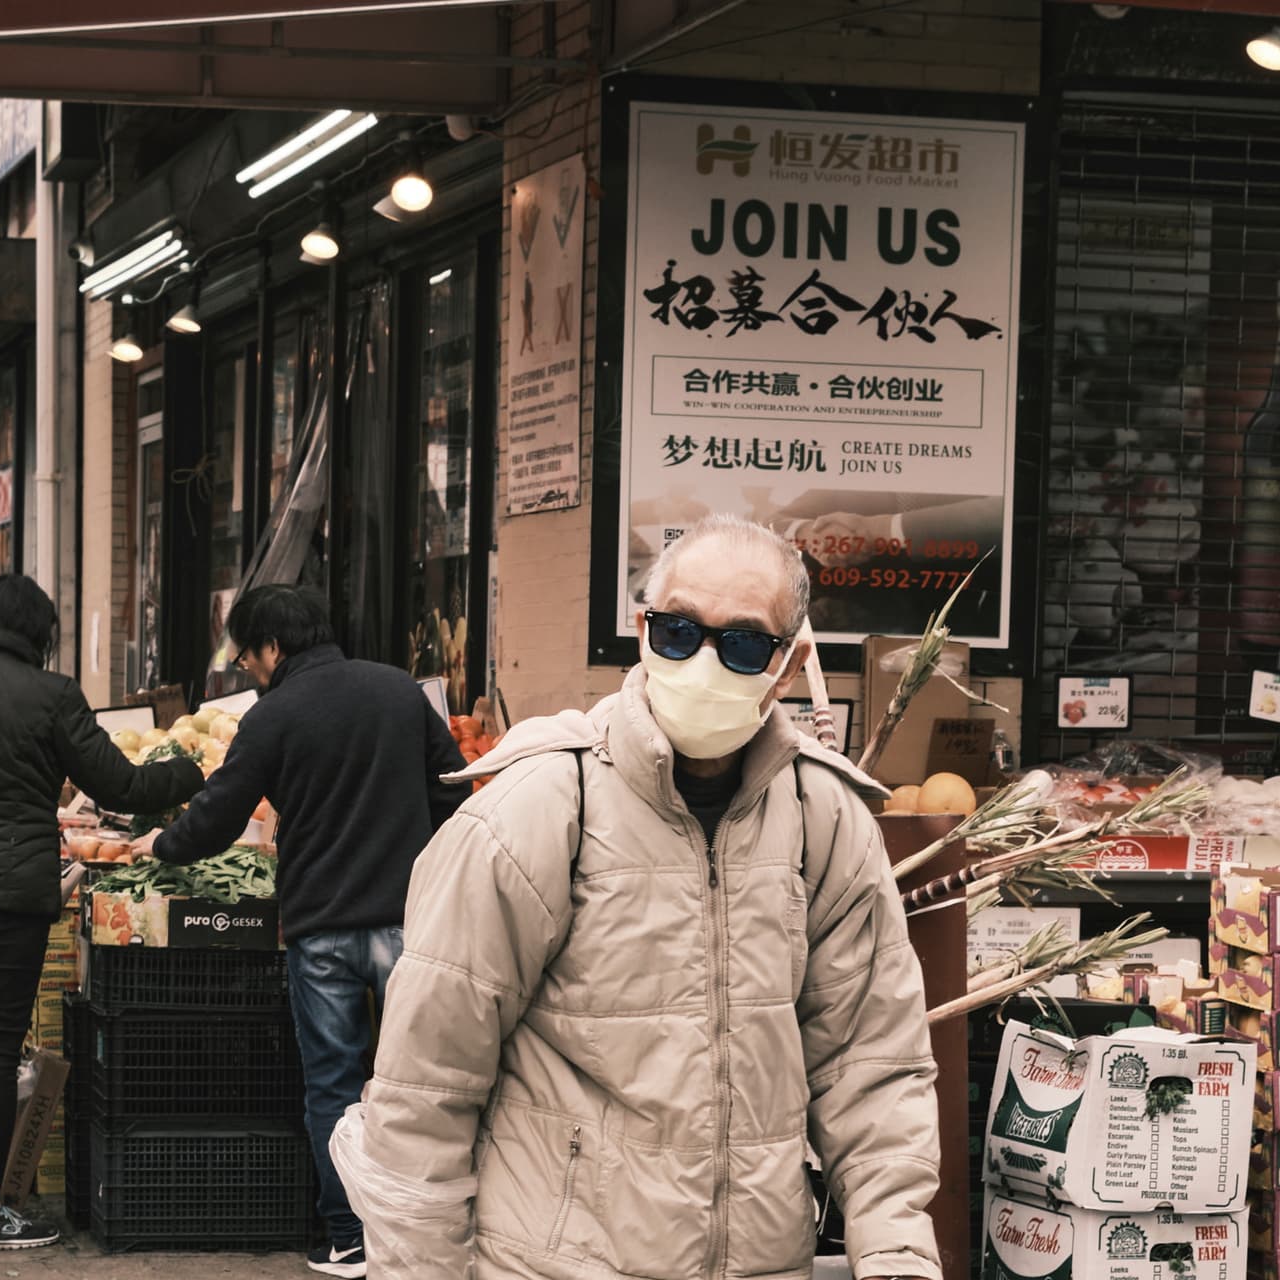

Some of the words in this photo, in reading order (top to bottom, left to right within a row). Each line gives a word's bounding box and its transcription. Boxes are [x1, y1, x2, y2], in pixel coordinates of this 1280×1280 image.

[770, 128, 961, 175] 恒发超市
[866, 173, 903, 187] Food
[908, 175, 960, 189] Market
[691, 198, 849, 262] JOIN
[877, 207, 961, 267] US
[644, 260, 1003, 344] 招募合伙人
[733, 402, 809, 413] COOPERATION
[812, 405, 835, 415] AND
[838, 406, 943, 419] ENTREPRENEURSHIP
[662, 433, 827, 473] 梦想起航
[841, 440, 904, 457] CREATE
[908, 443, 973, 459] DREAMS
[839, 459, 877, 475] JOIN
[882, 460, 903, 474] US
[1194, 838, 1209, 861] FUJI
[231, 918, 264, 927] GESEX
[1162, 1049, 1178, 1058] 1.35
[1022, 1047, 1054, 1086] Farm
[1197, 1061, 1234, 1076] FRESH
[1197, 1081, 1230, 1097] FARM
[1109, 1104, 1138, 1113] Dandelion
[1006, 1101, 1064, 1144] VEGETABLES
[1173, 1116, 1187, 1125] Kale
[1108, 1123, 1120, 1131] Red
[1172, 1125, 1199, 1134] Mustard
[1107, 1132, 1134, 1141] Escarole
[1172, 1136, 1187, 1144] Tops
[1107, 1142, 1128, 1150] Endive
[1193, 1146, 1218, 1155] Spinach
[1106, 1151, 1123, 1161] Curly
[1124, 1152, 1147, 1161] Parsley
[1172, 1154, 1197, 1163] Spinach
[1106, 1161, 1123, 1169] Plain
[1124, 1162, 1146, 1171] Parsley
[1105, 1170, 1117, 1178] Red
[1118, 1170, 1133, 1179] Leaf
[1170, 1173, 1194, 1182] Turnips
[1105, 1179, 1123, 1188] Green
[1124, 1180, 1139, 1189] Leaf
[1170, 1182, 1187, 1191] Other
[1140, 1190, 1167, 1200] PRODUCE
[1168, 1191, 1176, 1200] OF
[1177, 1191, 1189, 1201] USA
[1156, 1213, 1170, 1225] 1.35
[996, 1207, 1025, 1248] Farm
[1024, 1217, 1061, 1257] Fresh
[1195, 1224, 1229, 1241] FRESH
[1197, 1246, 1227, 1262] FARM
[1110, 1266, 1129, 1274] Leeks
